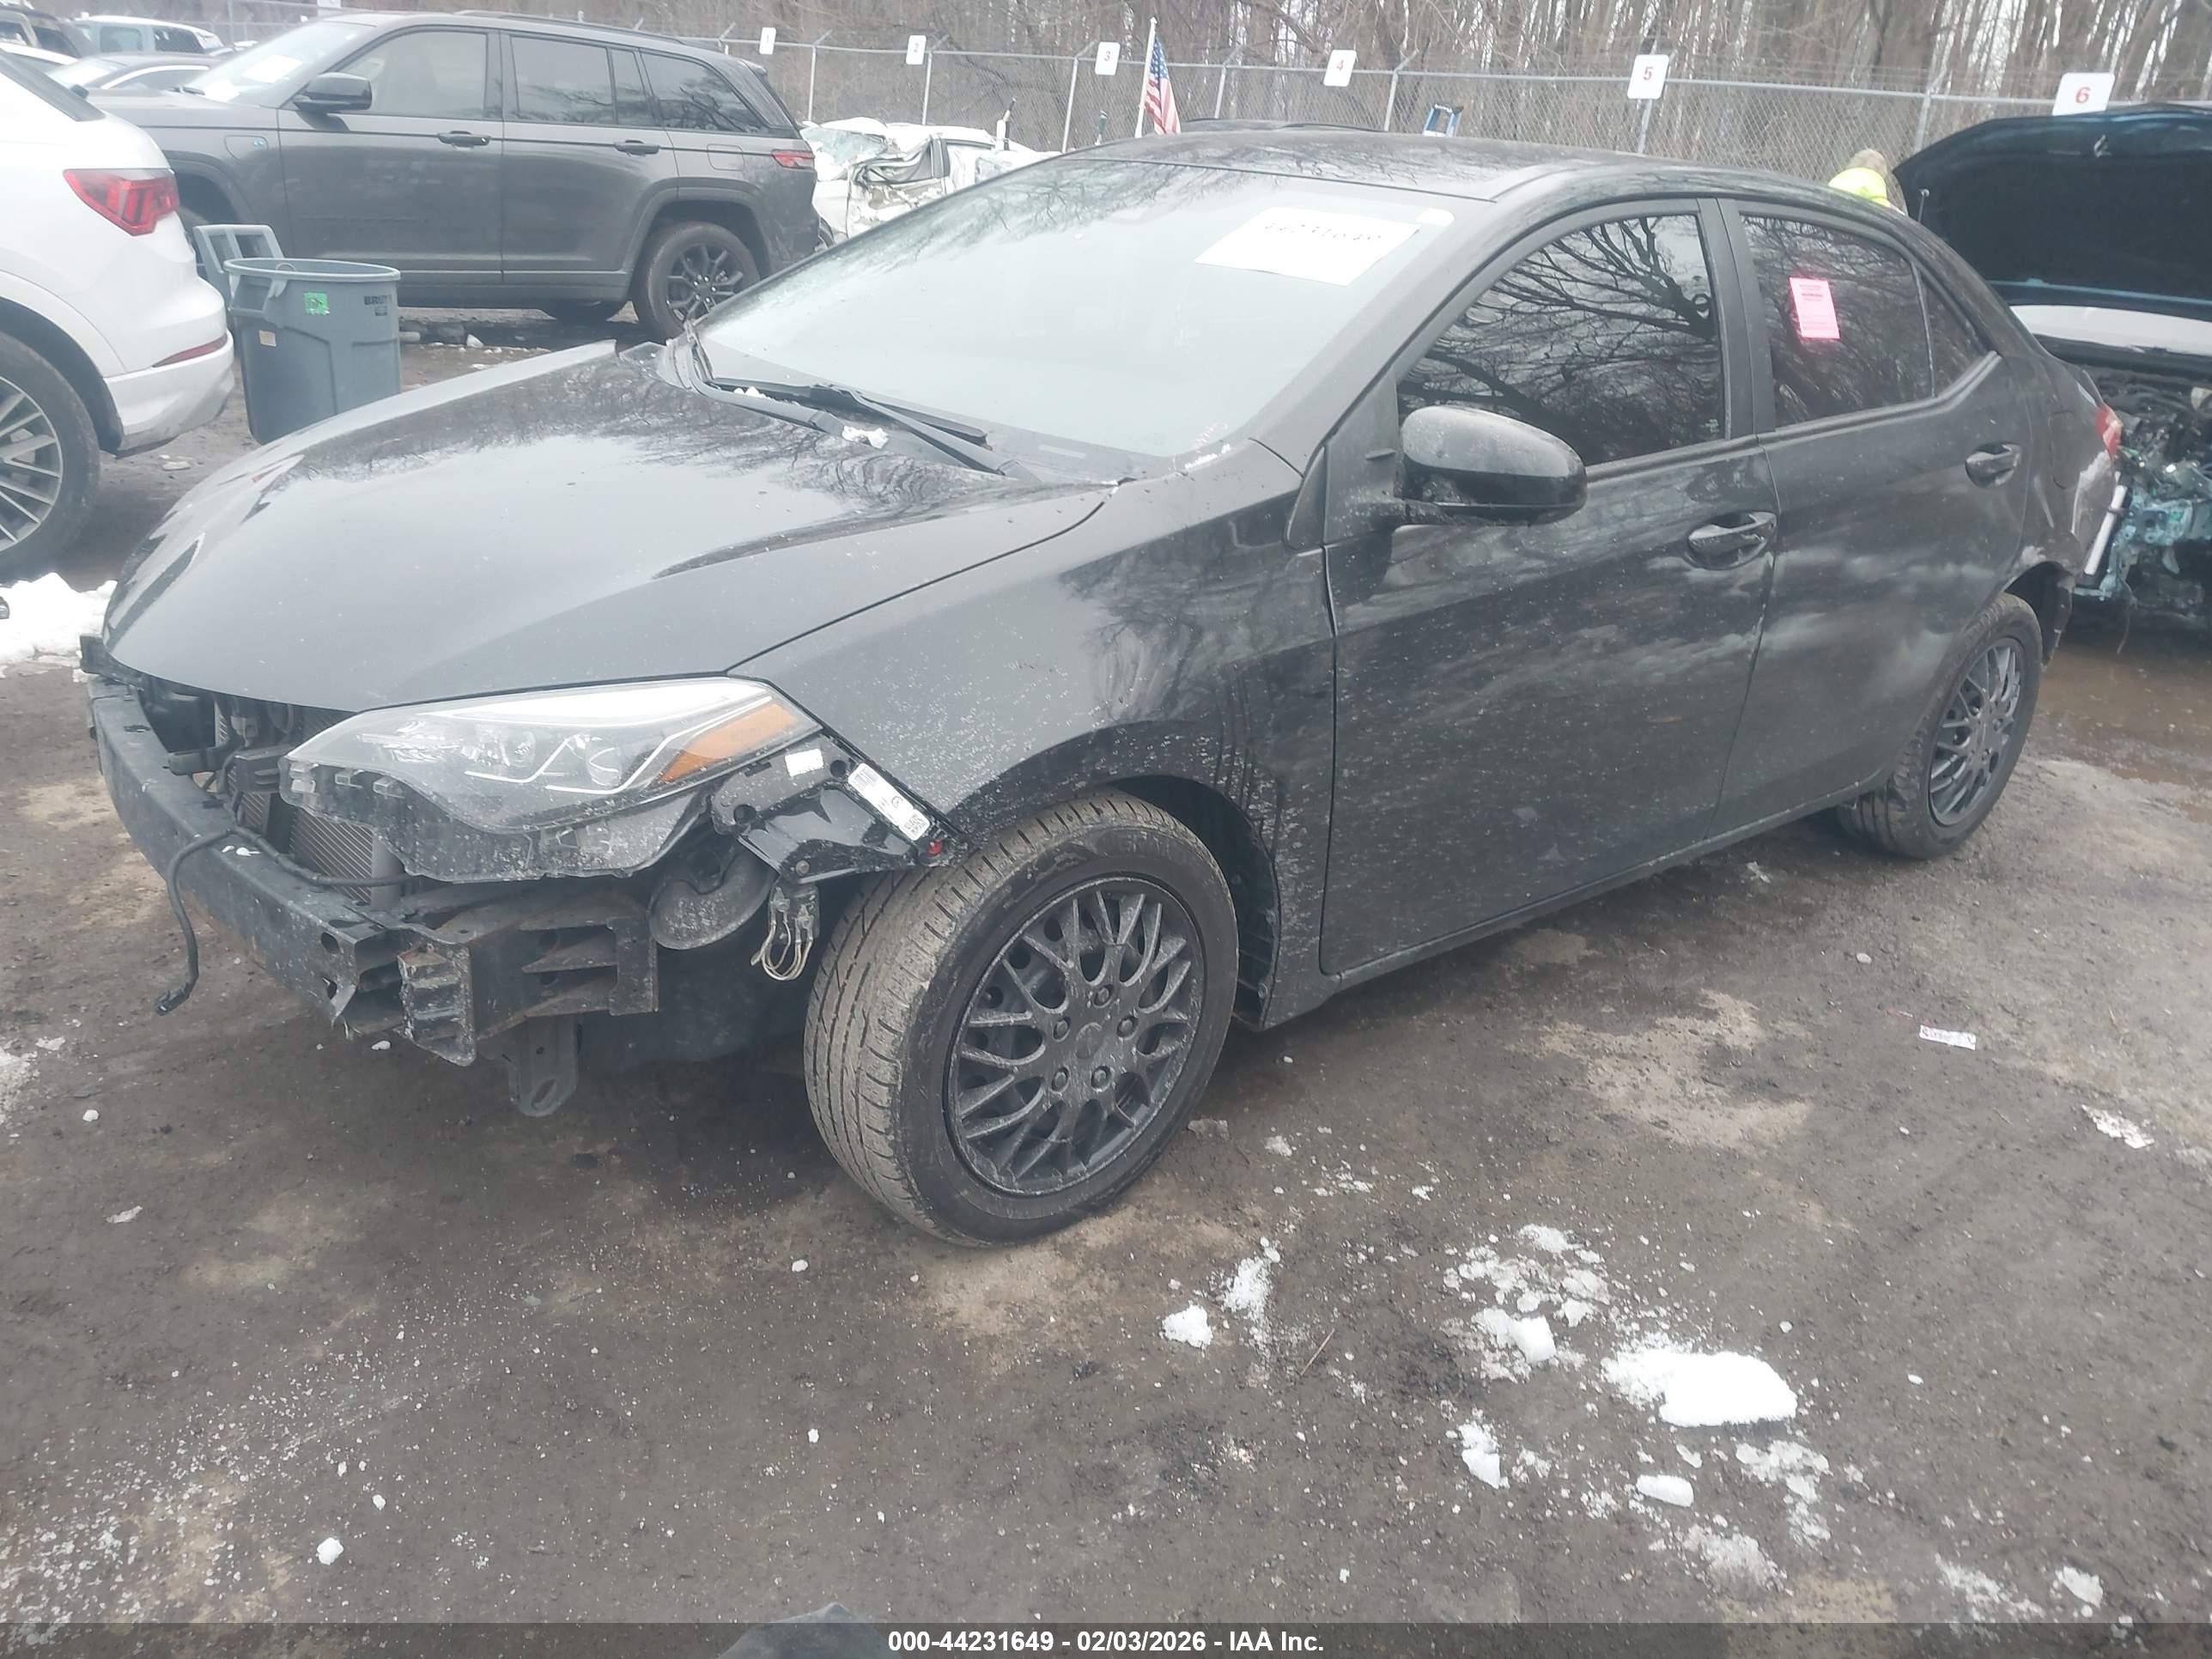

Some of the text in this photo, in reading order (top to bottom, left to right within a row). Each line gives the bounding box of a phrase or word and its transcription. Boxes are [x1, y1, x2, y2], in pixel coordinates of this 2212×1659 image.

[1104, 50, 1111, 62] 3
[1336, 59, 1345, 71] 4
[1643, 66, 1654, 81] 5
[2075, 86, 2091, 104] 6
